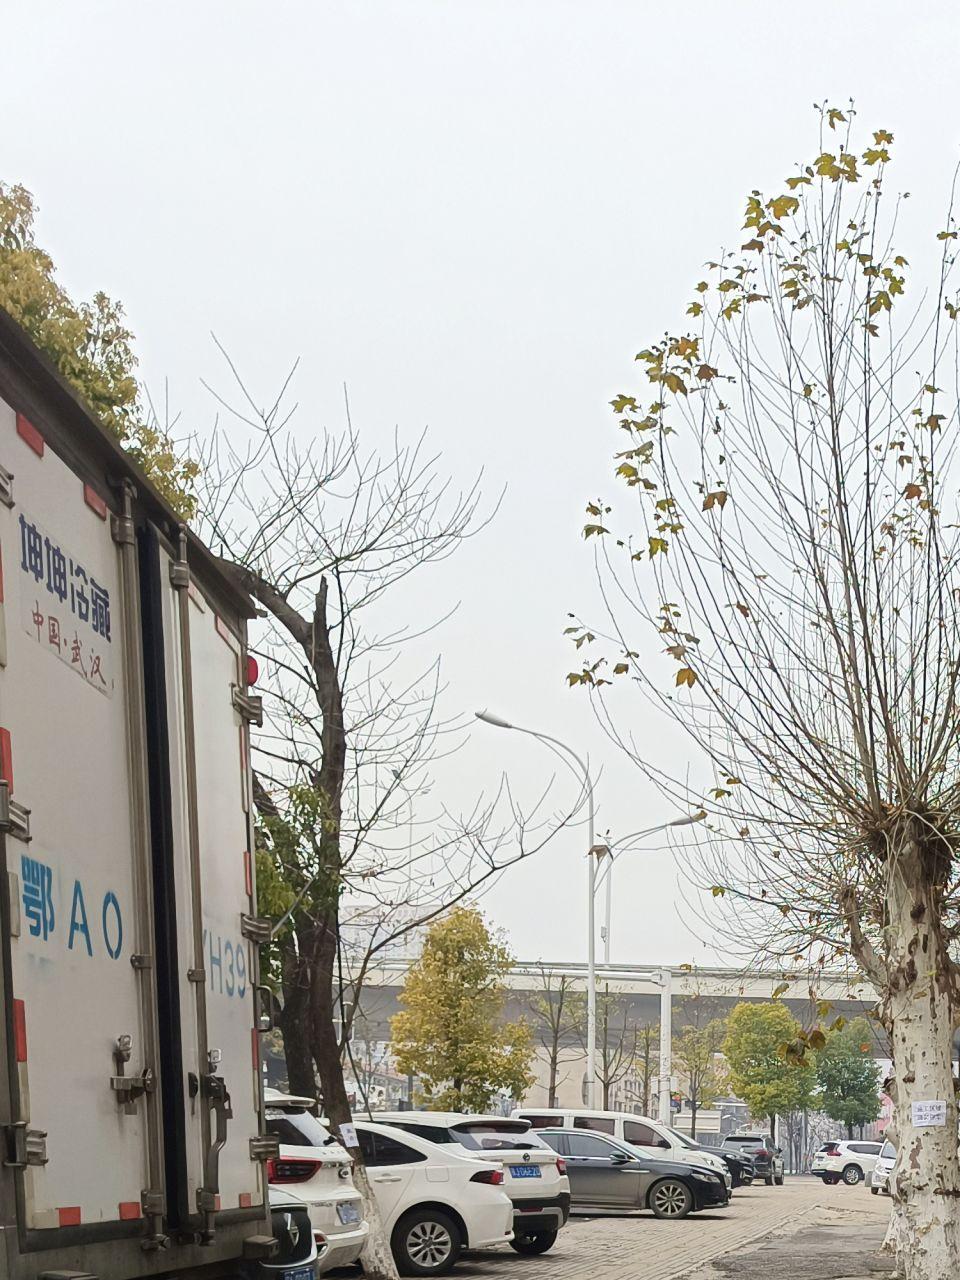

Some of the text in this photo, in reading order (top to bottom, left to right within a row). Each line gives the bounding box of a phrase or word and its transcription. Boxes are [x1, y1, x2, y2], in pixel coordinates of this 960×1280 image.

[19, 513, 112, 643] 坤坤冷藏
[203, 929, 247, 999] H39
